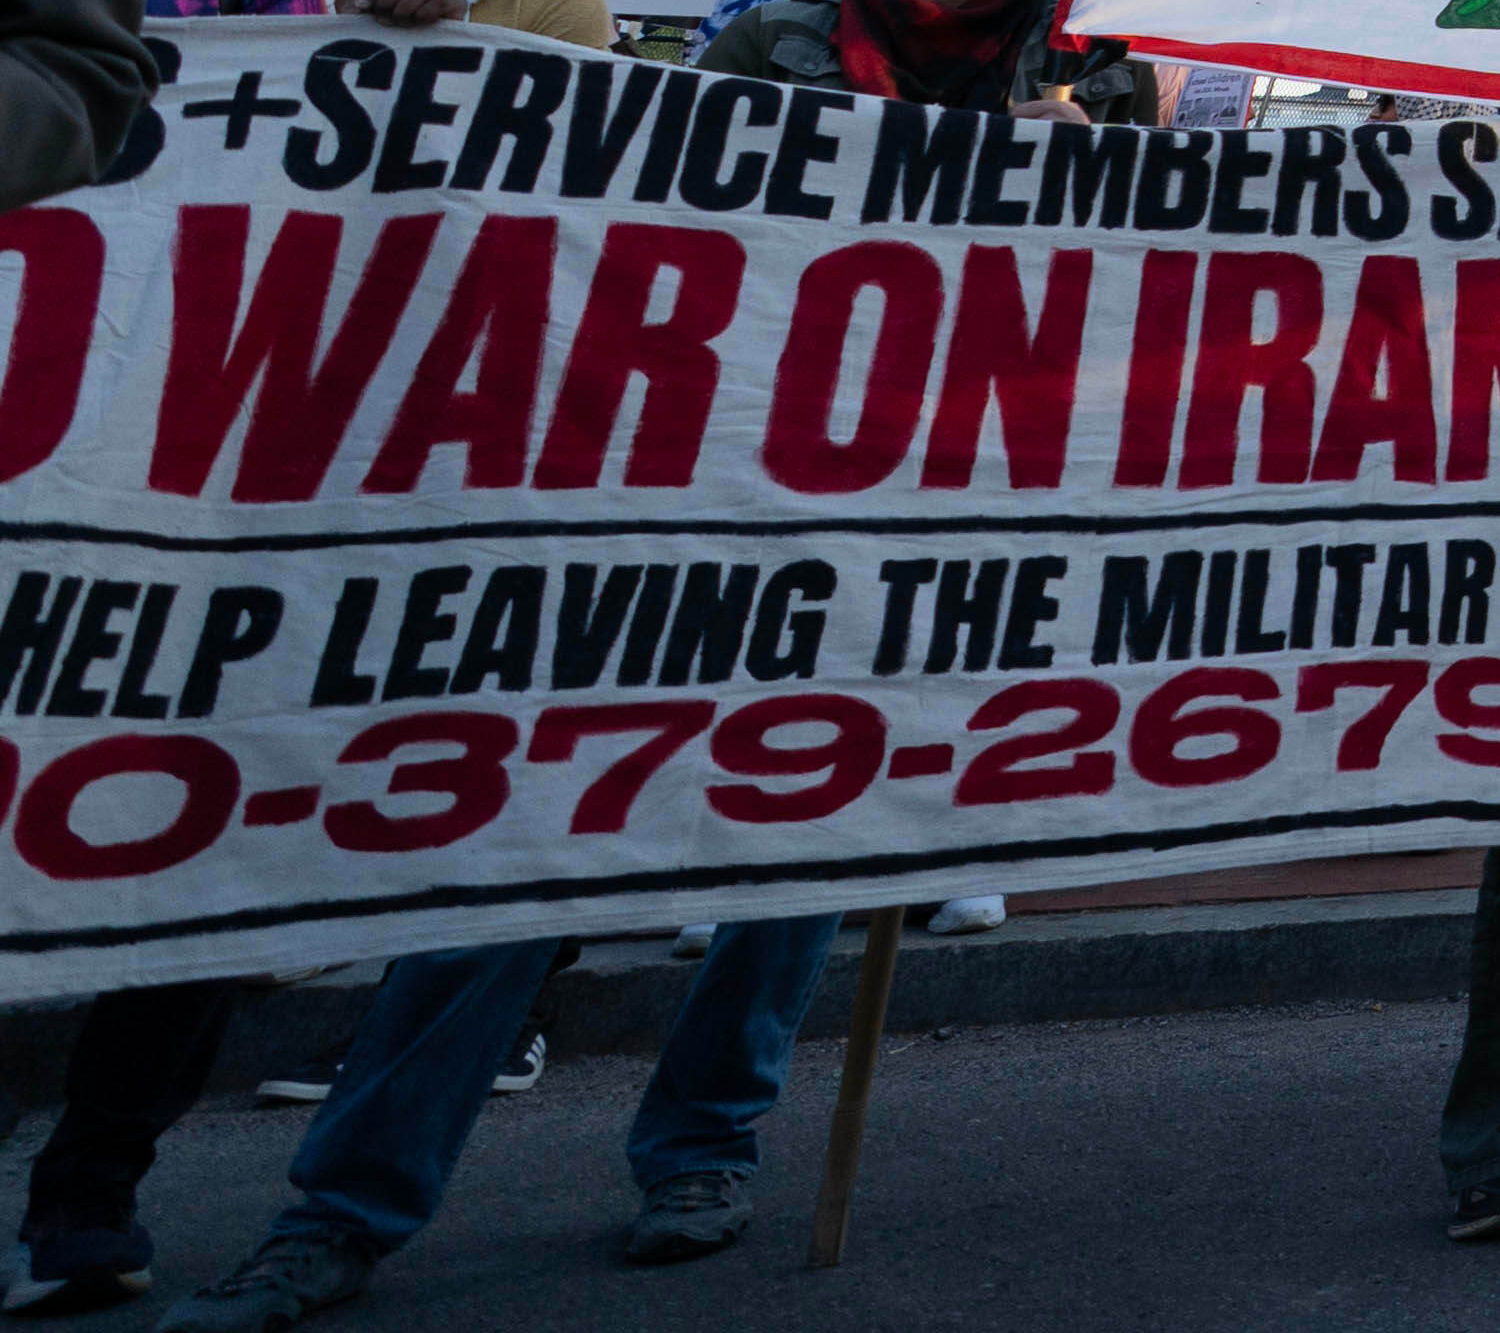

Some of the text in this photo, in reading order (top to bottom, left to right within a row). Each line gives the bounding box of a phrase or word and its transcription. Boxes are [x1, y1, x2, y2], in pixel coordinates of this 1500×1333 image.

[860, 99, 1411, 243] MEMBERS
[146, 203, 748, 505] WAR
[755, 237, 1093, 494] ON
[0, 569, 285, 721] HELP
[309, 558, 839, 709] LEAVING
[871, 552, 1069, 677] THE
